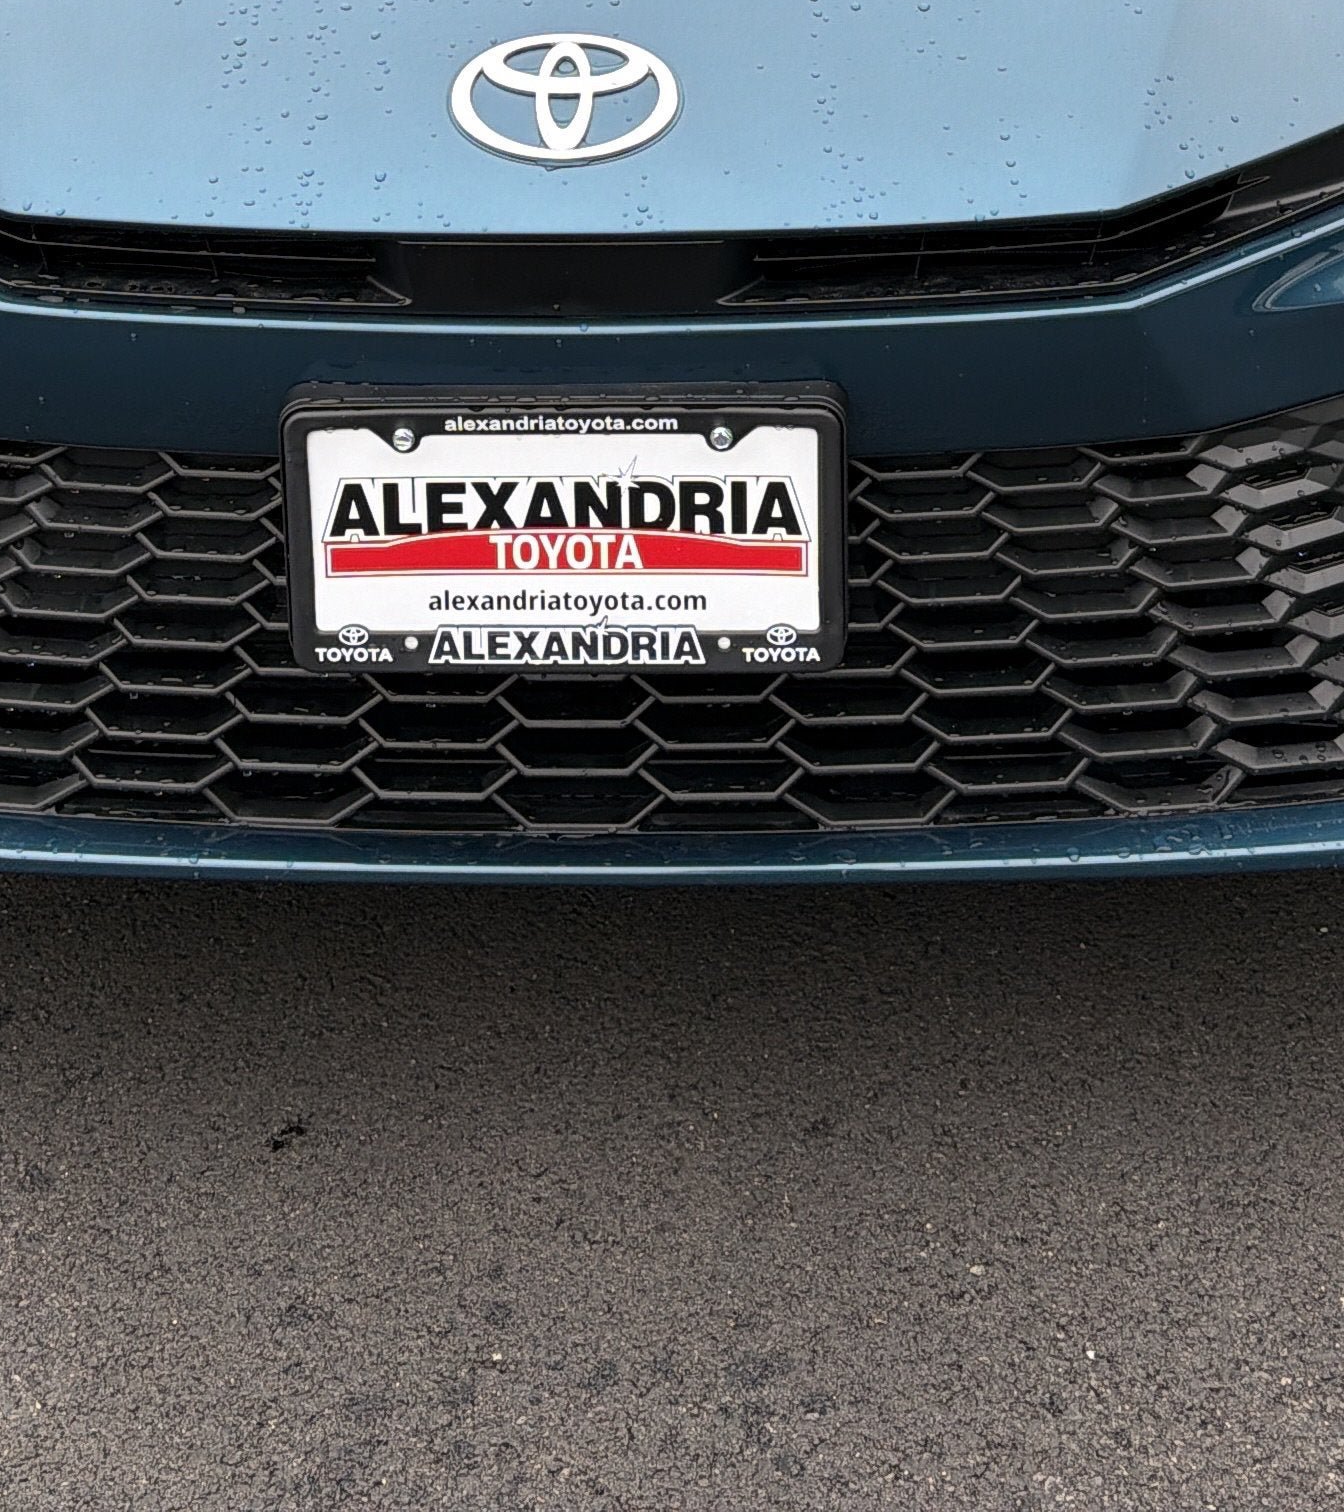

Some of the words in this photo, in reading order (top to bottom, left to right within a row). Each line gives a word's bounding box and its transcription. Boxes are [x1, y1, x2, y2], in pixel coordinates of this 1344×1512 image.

[443, 415, 679, 435] alexandriatoyota.com
[328, 479, 804, 538] ALEXANDRIA
[488, 533, 645, 570] TOYOTA
[428, 589, 708, 616] alexandriatoyota.com
[315, 646, 394, 663] TOYOTA
[432, 627, 704, 663] ALEXANDRIA
[742, 646, 821, 664] TOYOTA
